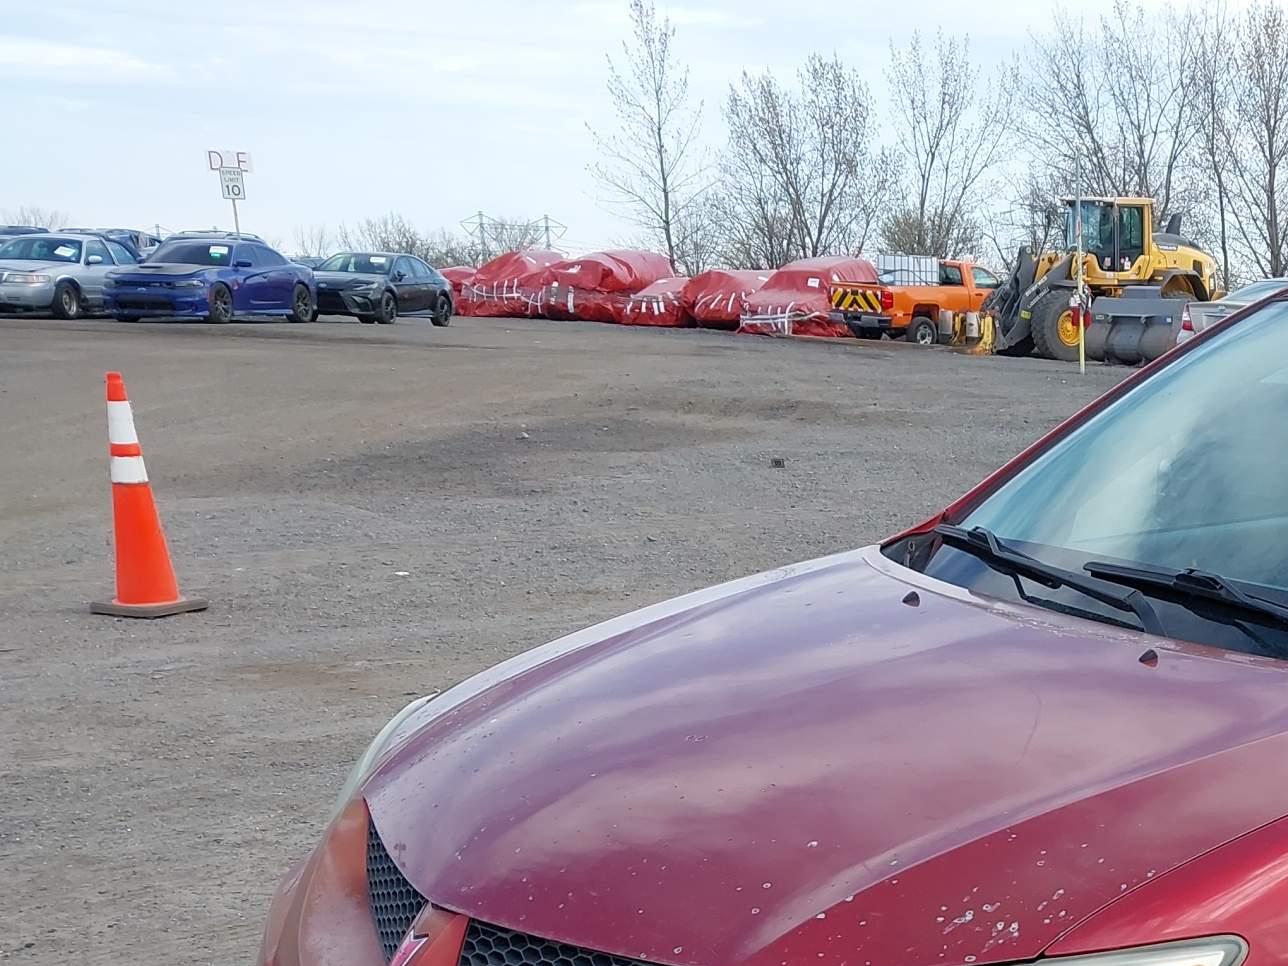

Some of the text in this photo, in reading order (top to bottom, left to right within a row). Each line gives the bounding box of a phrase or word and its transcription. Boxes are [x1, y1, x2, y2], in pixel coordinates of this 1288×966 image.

[208, 150, 249, 172] D E
[225, 184, 241, 196] 10
